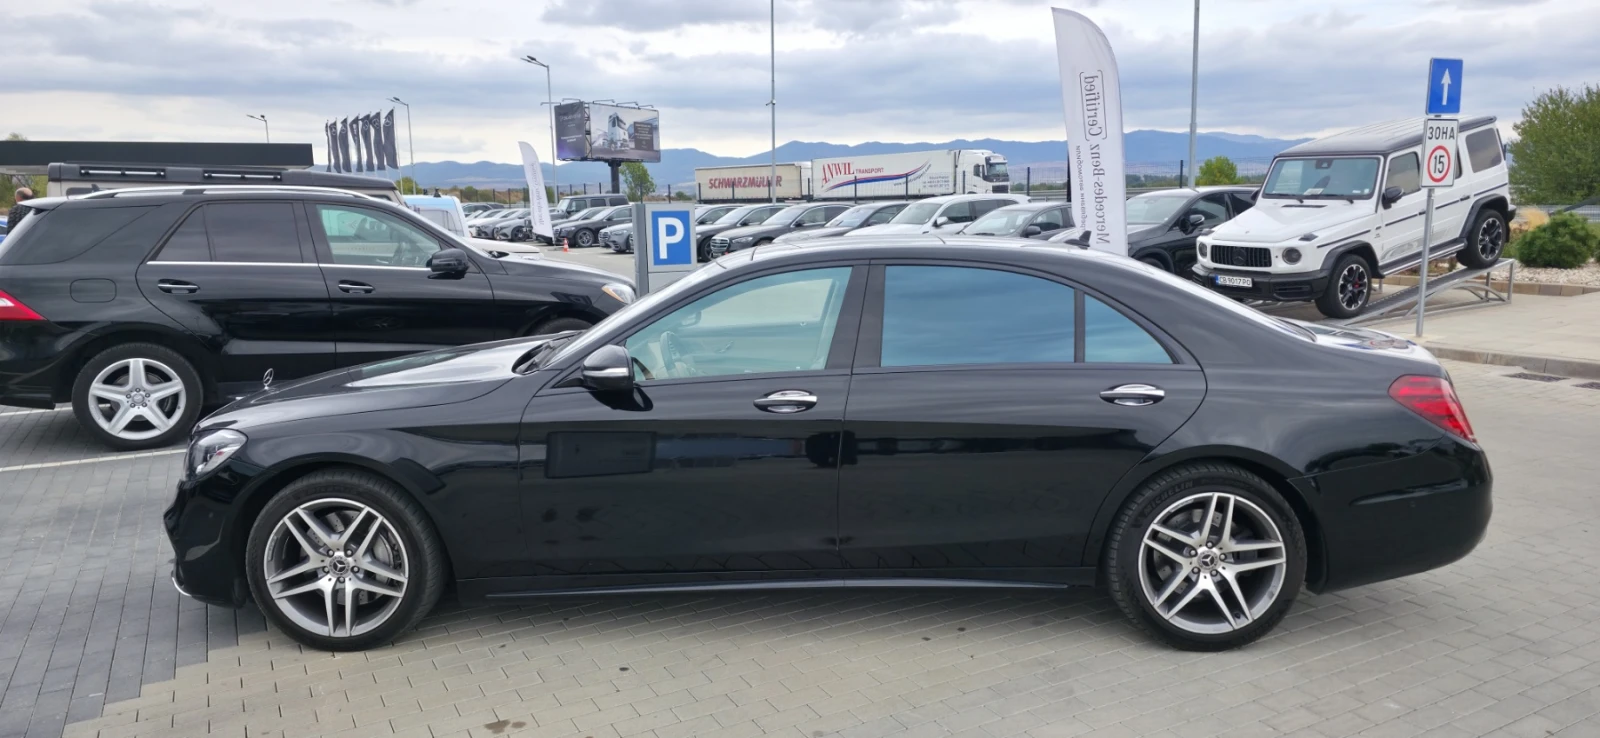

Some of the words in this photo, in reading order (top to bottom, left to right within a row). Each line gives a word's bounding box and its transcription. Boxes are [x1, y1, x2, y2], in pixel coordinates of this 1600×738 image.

[1428, 126, 1455, 140] ЗОНА
[1433, 154, 1446, 174] 15
[708, 175, 783, 190] SCHWARZMÜLLR
[821, 162, 855, 188] ANWIL
[855, 167, 885, 175] TRANSPORT
[657, 216, 685, 260] P
